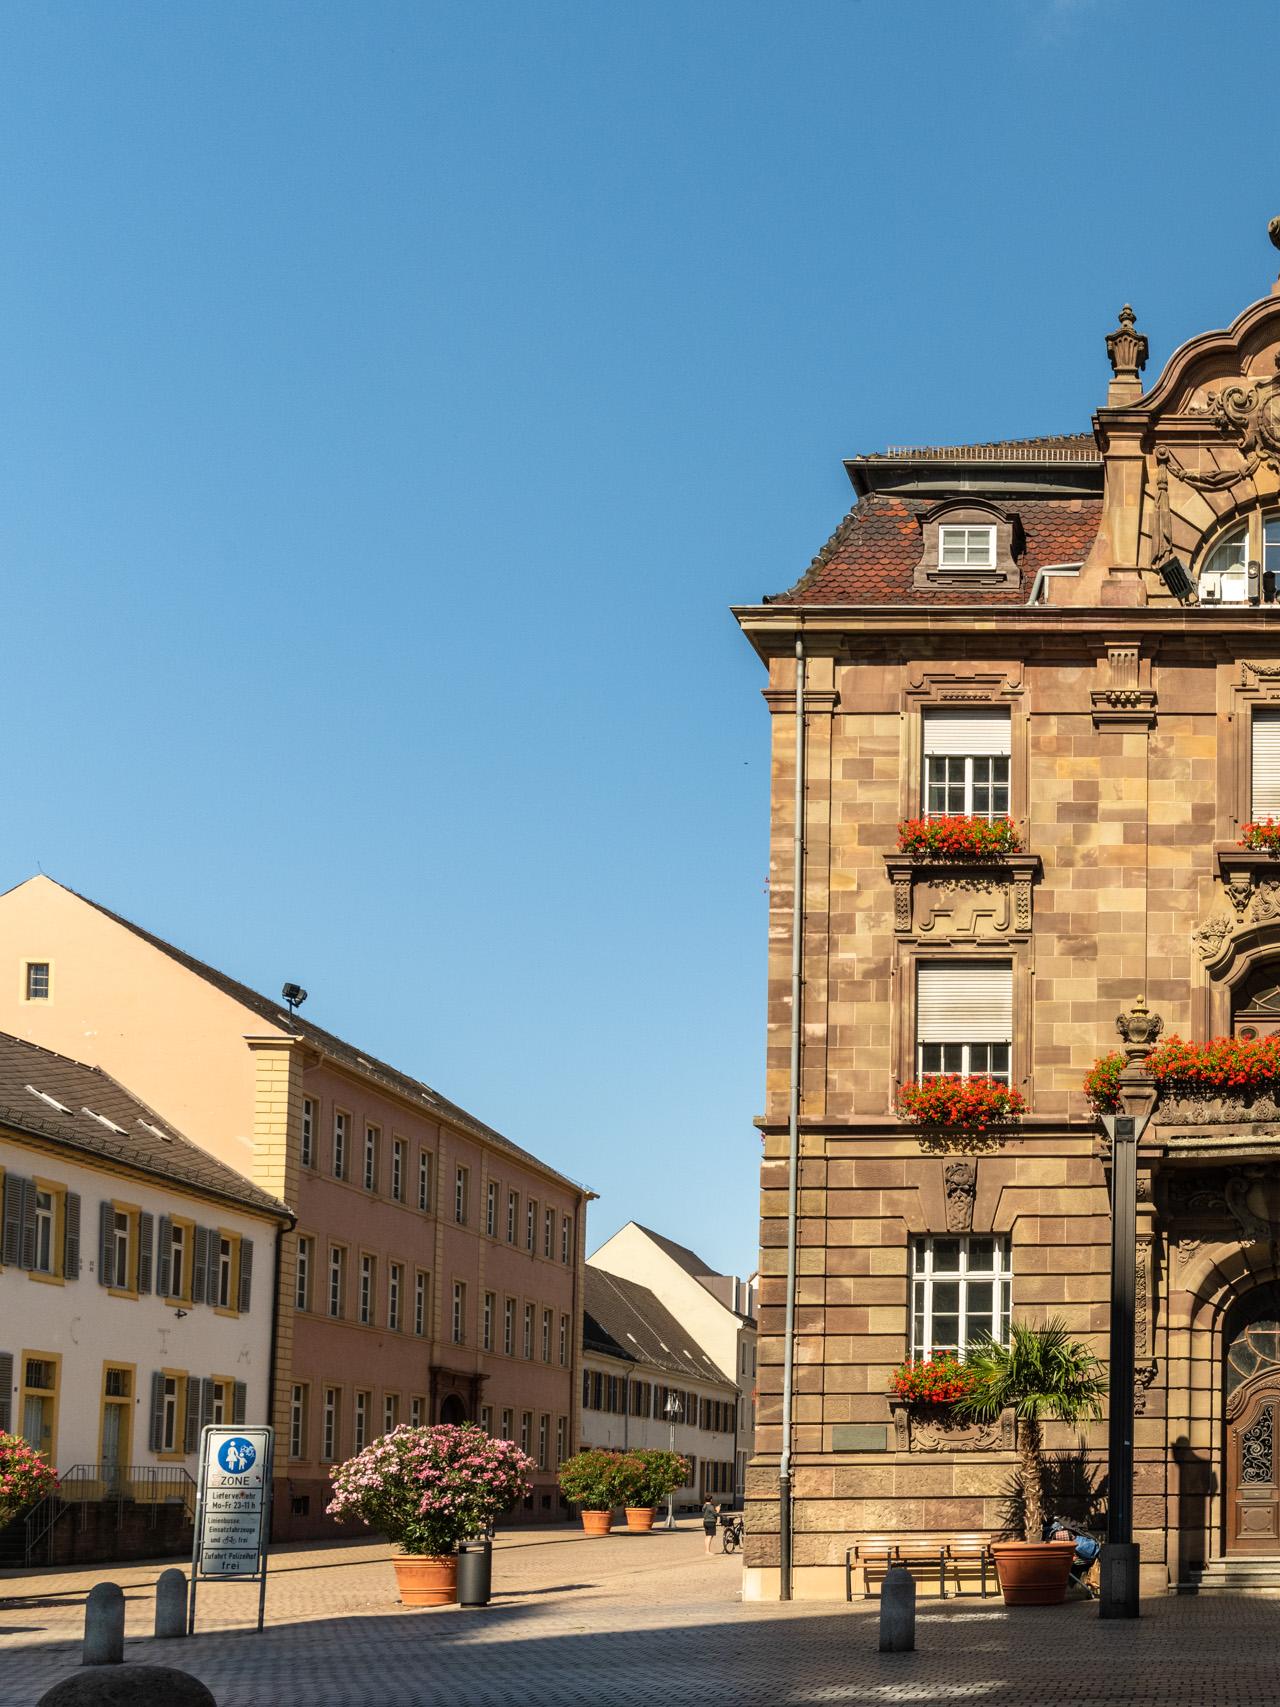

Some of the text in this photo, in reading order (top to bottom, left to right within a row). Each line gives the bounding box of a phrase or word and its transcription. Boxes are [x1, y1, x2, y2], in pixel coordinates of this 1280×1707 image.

[221, 1476, 250, 1485] ZONE
[212, 1491, 256, 1500] Lieferveehr
[212, 1501, 232, 1509] Mo-Fr
[221, 1561, 241, 1570] frei
